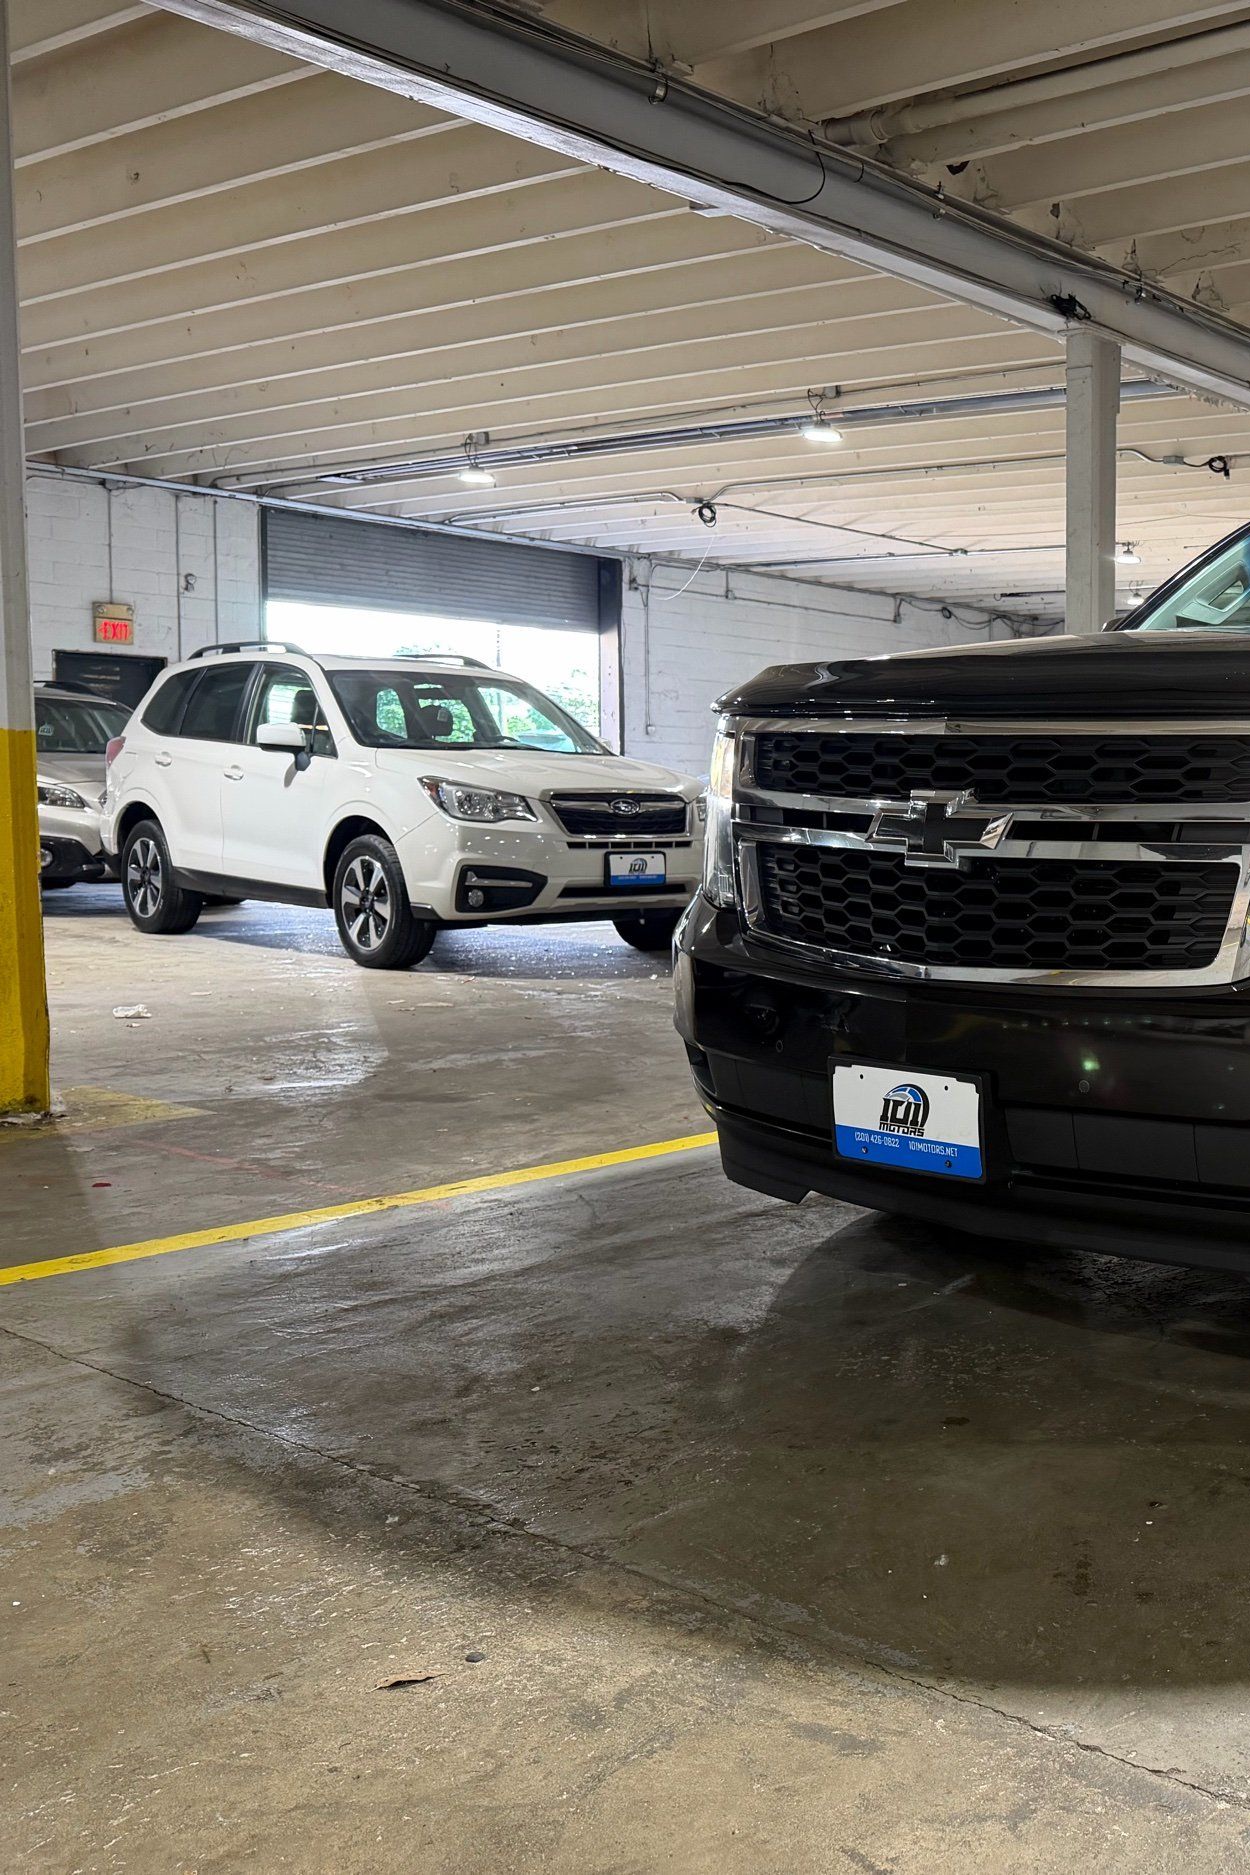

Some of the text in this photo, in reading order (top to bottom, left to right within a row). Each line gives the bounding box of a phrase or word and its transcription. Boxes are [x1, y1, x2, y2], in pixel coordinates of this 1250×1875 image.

[103, 621, 128, 640] EXIT
[879, 1121, 925, 1138] MOTORS
[908, 1140, 958, 1157] 101MOTORS.NET
